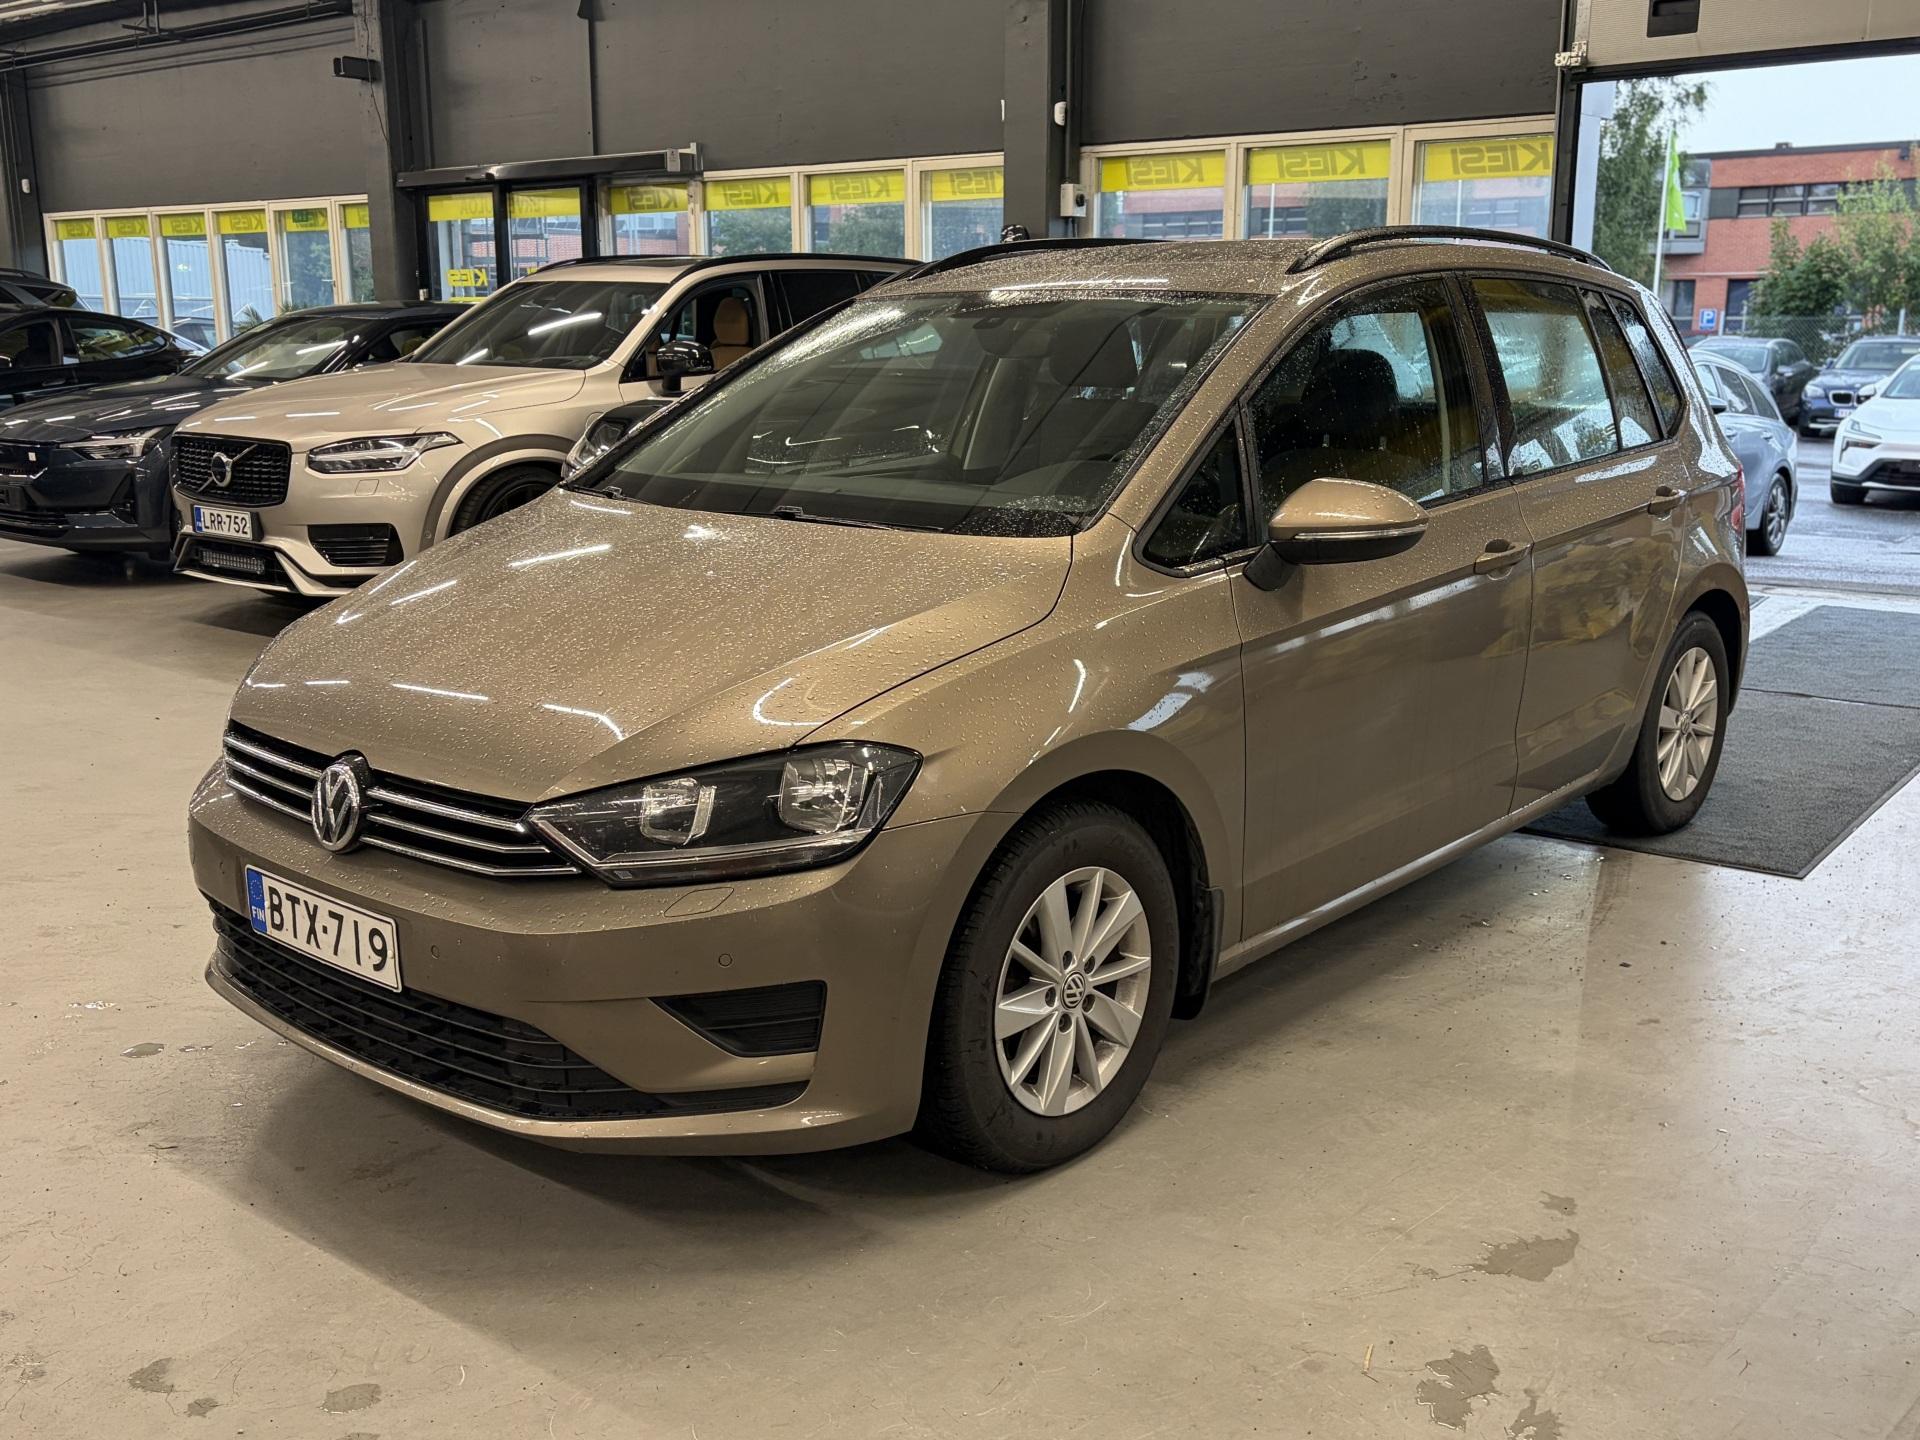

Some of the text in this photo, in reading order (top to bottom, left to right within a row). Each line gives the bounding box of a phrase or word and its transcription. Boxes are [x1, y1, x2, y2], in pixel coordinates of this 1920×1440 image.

[202, 511, 248, 535] LRR-752
[251, 905, 266, 923] FIN
[268, 885, 388, 972] BTX-719
